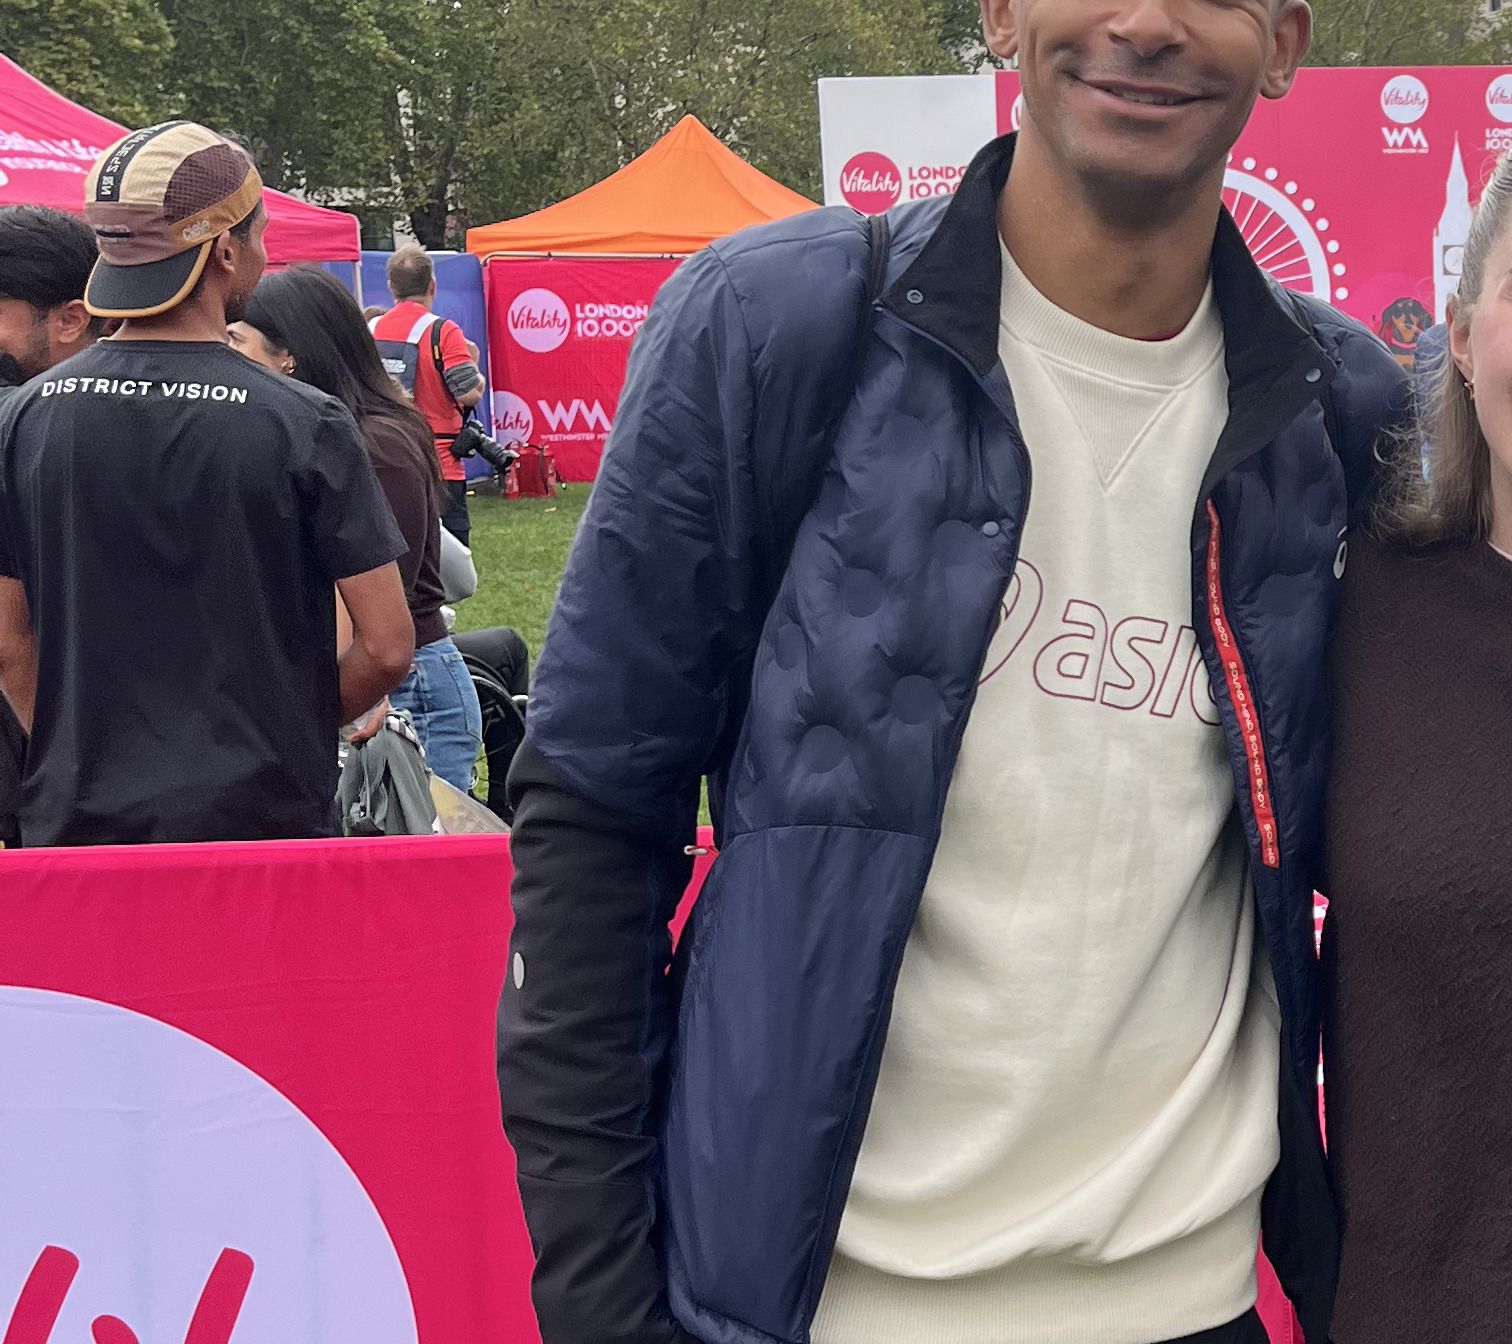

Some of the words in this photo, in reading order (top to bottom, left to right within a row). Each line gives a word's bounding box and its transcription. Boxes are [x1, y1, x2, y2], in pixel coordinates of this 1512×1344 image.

[1384, 88, 1426, 110] Vitality
[842, 167, 900, 199] Vitality
[511, 305, 567, 336] Vitality
[575, 303, 650, 320] LONDON
[41, 377, 152, 398] DISTRICT
[161, 383, 248, 404] VISION
[1229, 662, 1245, 701] SOUND
